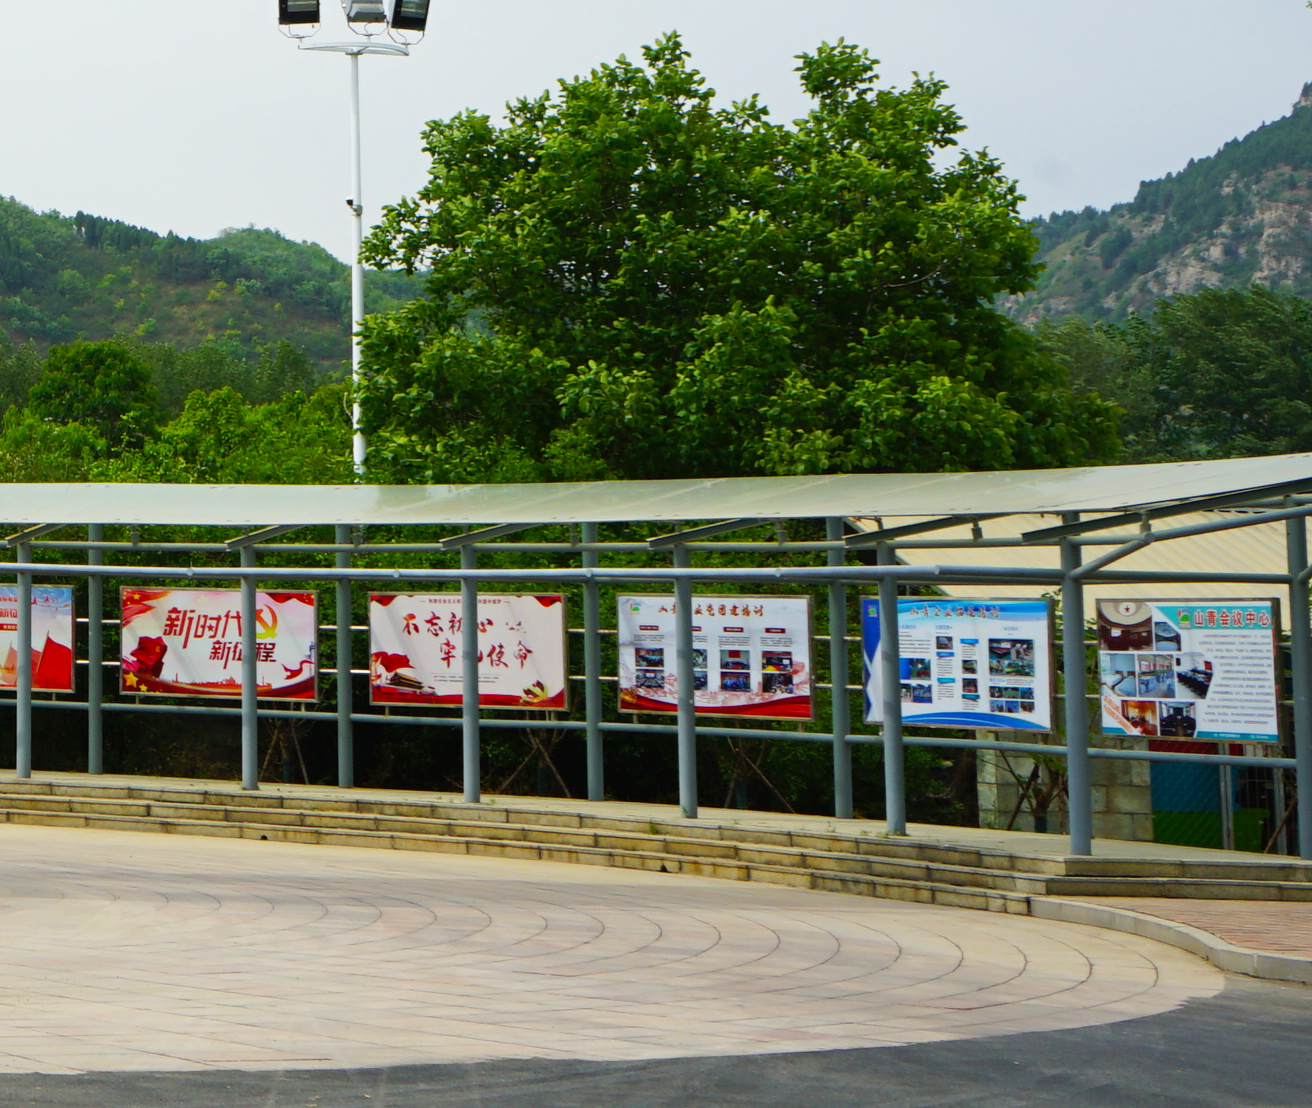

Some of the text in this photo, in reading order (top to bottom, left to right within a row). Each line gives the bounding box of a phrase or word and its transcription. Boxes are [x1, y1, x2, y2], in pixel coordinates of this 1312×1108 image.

[658, 602, 765, 617] 山青业党团建培训
[1194, 609, 1271, 627] 山青会议中心
[162, 606, 242, 649] 新时代
[439, 638, 534, 669] 牢使命
